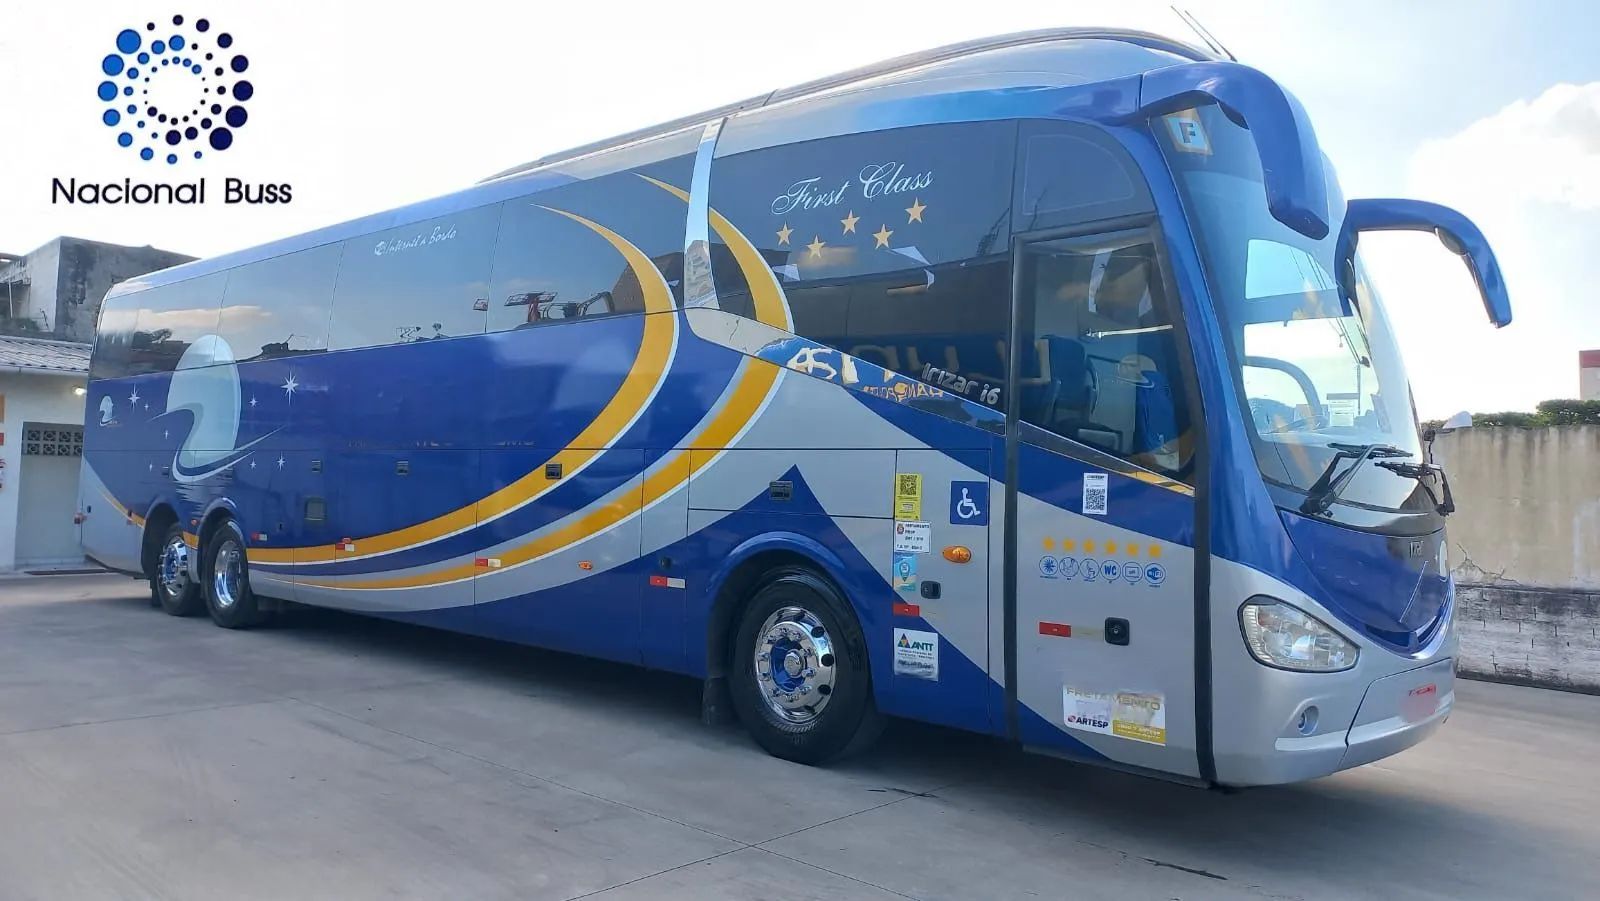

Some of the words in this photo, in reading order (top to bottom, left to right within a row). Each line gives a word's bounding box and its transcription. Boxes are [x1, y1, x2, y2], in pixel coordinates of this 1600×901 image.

[1179, 122, 1196, 144] F
[771, 176, 851, 215] First
[859, 161, 933, 202] Class
[921, 362, 979, 395] Irizar
[979, 383, 1001, 405] i6
[1104, 564, 1117, 576] WC
[911, 641, 934, 651] ANTT
[1076, 716, 1109, 729] ARTESP
